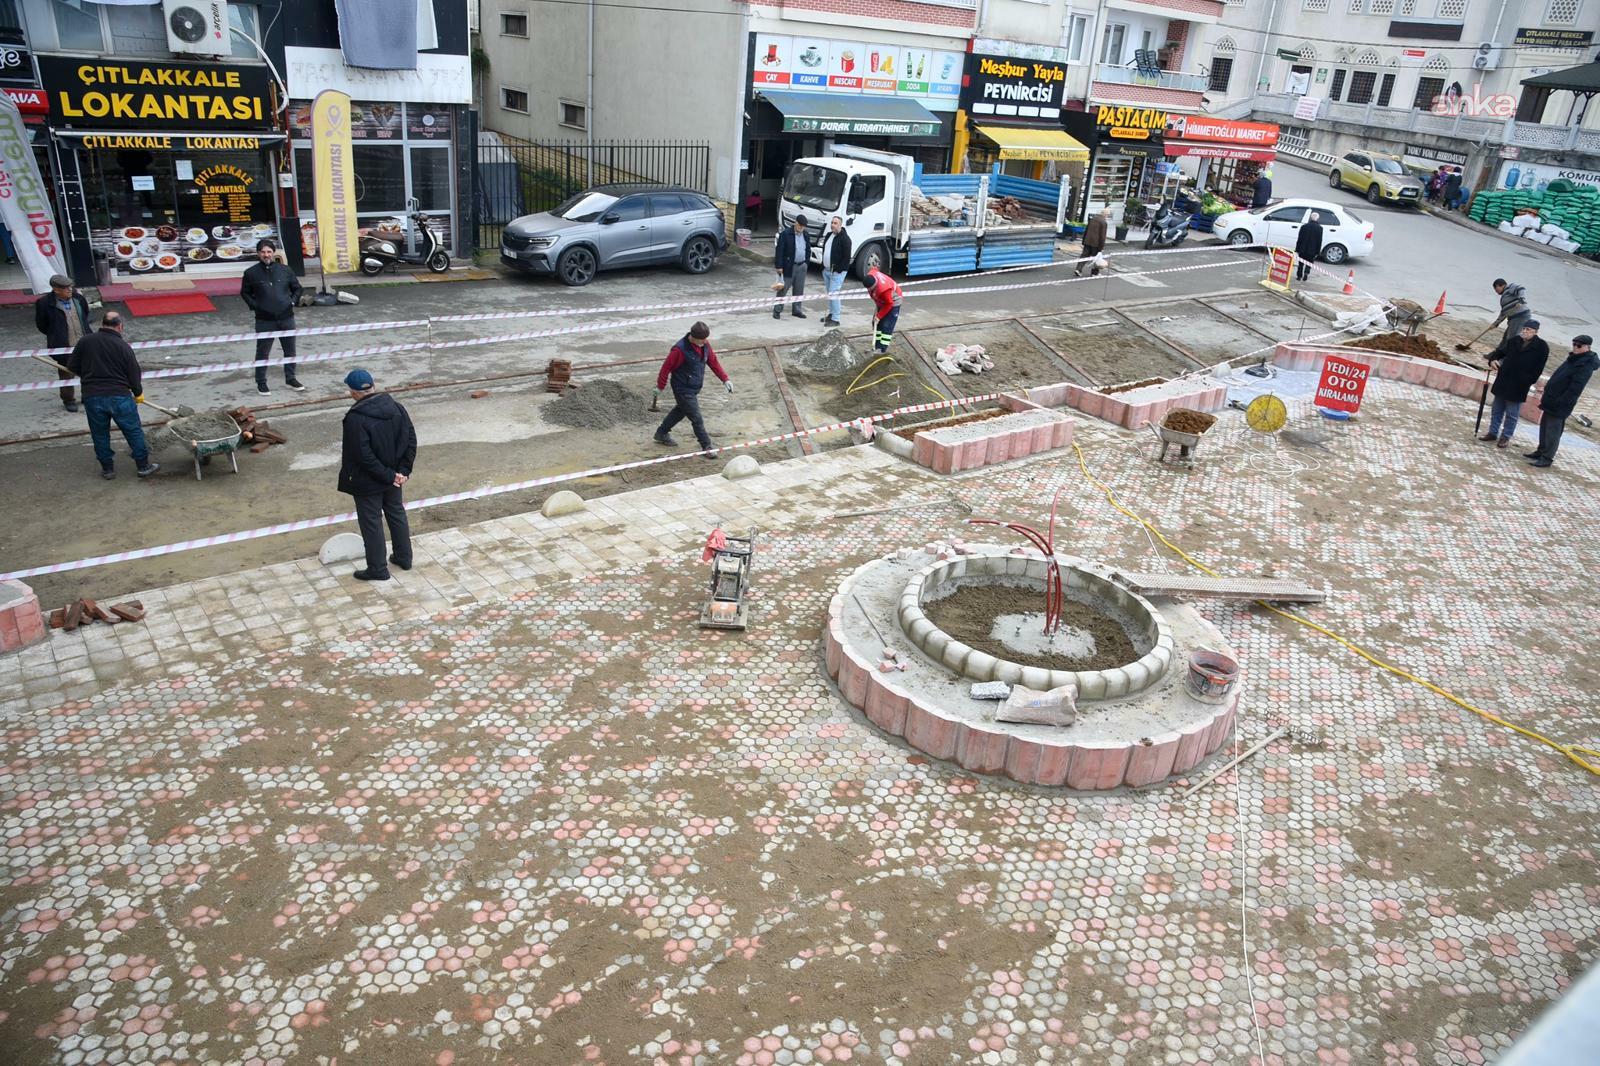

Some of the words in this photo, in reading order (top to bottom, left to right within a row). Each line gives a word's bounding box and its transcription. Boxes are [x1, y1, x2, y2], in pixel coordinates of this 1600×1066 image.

[78, 65, 241, 87] ÇITLAKKALE
[765, 73, 778, 83] ÇAY
[980, 58, 1027, 78] Meşhur
[1033, 63, 1064, 83] Yayla
[800, 76, 819, 84] KAHVE
[905, 82, 920, 90] SODA
[984, 81, 1054, 102] PEYNİRCİSİ
[59, 91, 263, 120] LOKANTASI
[1097, 104, 1167, 129] PASTACIM
[820, 121, 850, 131] DURAK
[1237, 128, 1267, 140] MARKET
[82, 135, 172, 149] ÇITLAKKALE
[186, 136, 260, 149] LOKANTASI
[194, 164, 254, 186] ÇITLAKKALE
[330, 143, 345, 205] LOKANTASI
[205, 184, 246, 194] LOKANTASI
[333, 207, 350, 271] ÇITLAKKALE
[1326, 361, 1366, 380] YEDİ/24
[1327, 375, 1358, 391] OTO
[1318, 386, 1360, 404] KİRALAMA
